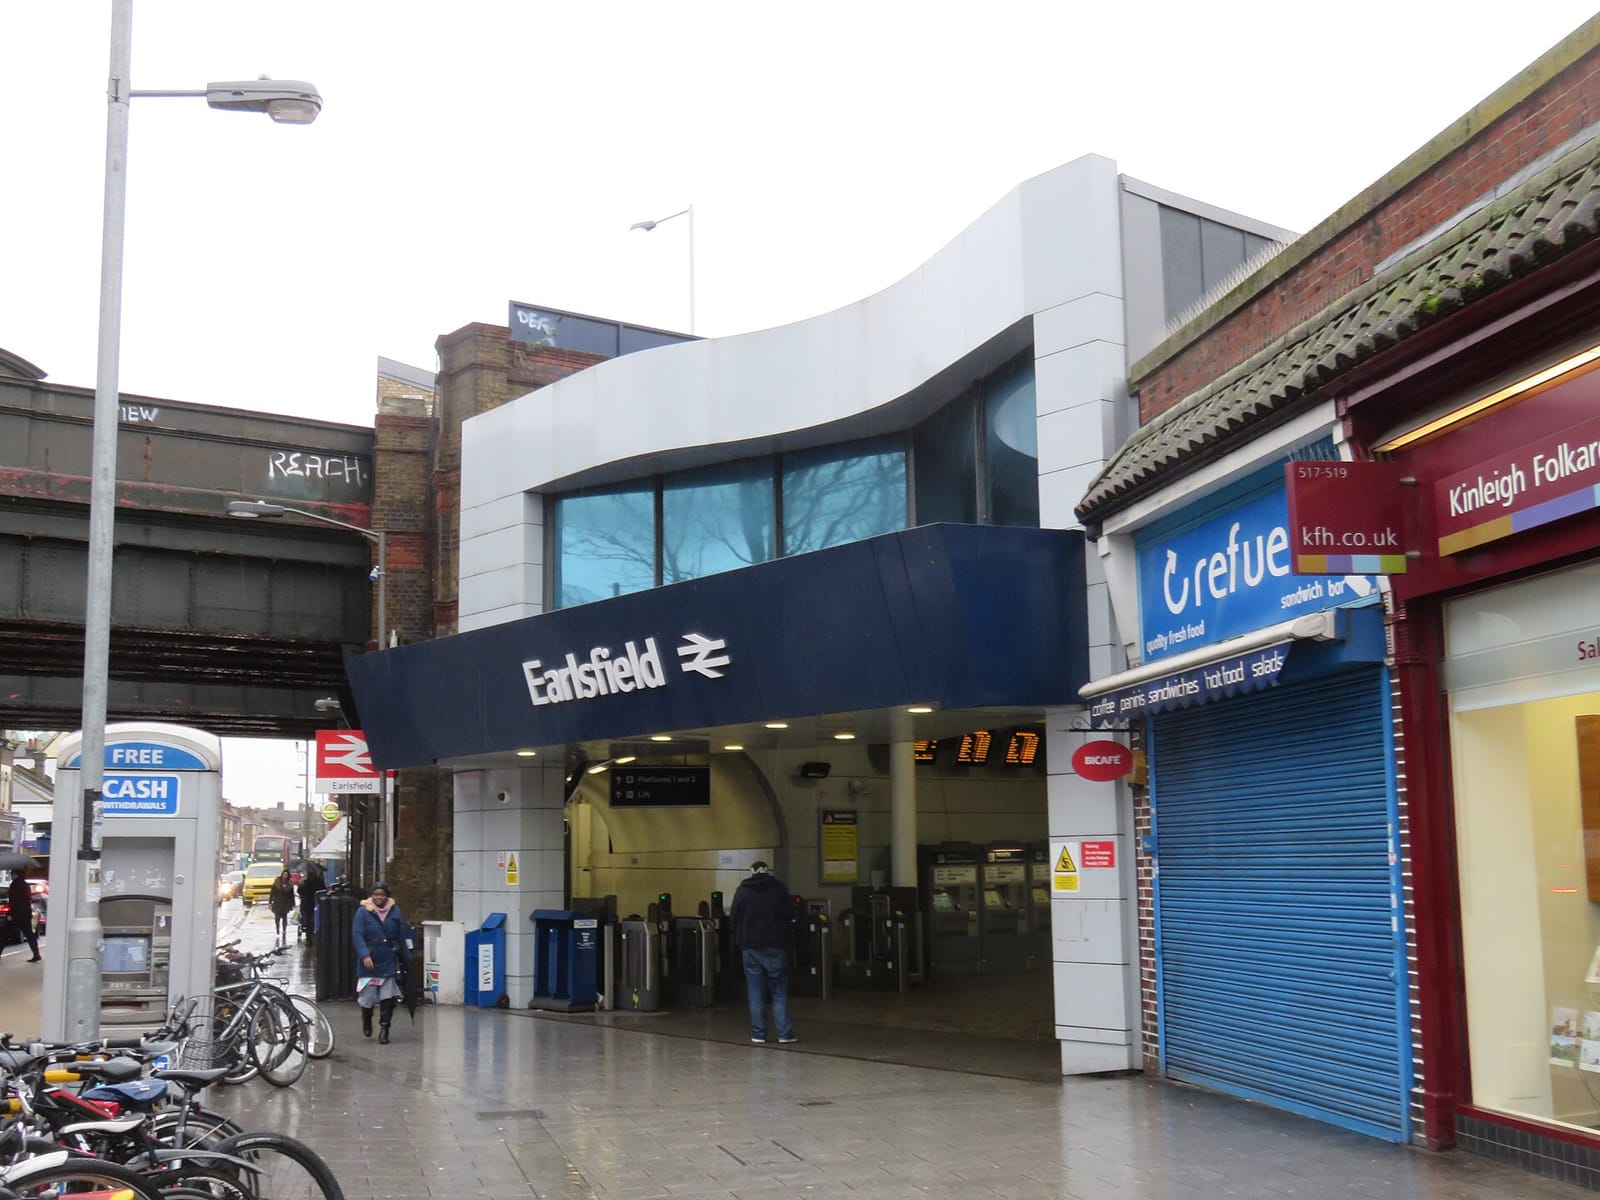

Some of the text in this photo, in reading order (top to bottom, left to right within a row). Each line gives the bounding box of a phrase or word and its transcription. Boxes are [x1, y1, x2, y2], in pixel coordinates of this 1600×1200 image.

[117, 405, 159, 421] IEW
[1298, 466, 1348, 479] 517-519
[1449, 442, 1600, 517] Kinleigh Folkar
[1301, 526, 1399, 547] kfh.co.uk
[1280, 578, 1345, 609] sandwich bar
[1146, 619, 1205, 656] quality fresh food
[521, 637, 667, 707] Earlsfield
[1091, 698, 1116, 717] coffee
[1148, 675, 1199, 704] sandwiches
[1251, 651, 1284, 678] salads
[112, 748, 164, 765] FREE
[1084, 754, 1121, 766] BICAFÉ
[102, 779, 168, 799] CASH
[332, 781, 373, 791] Earlsfield
